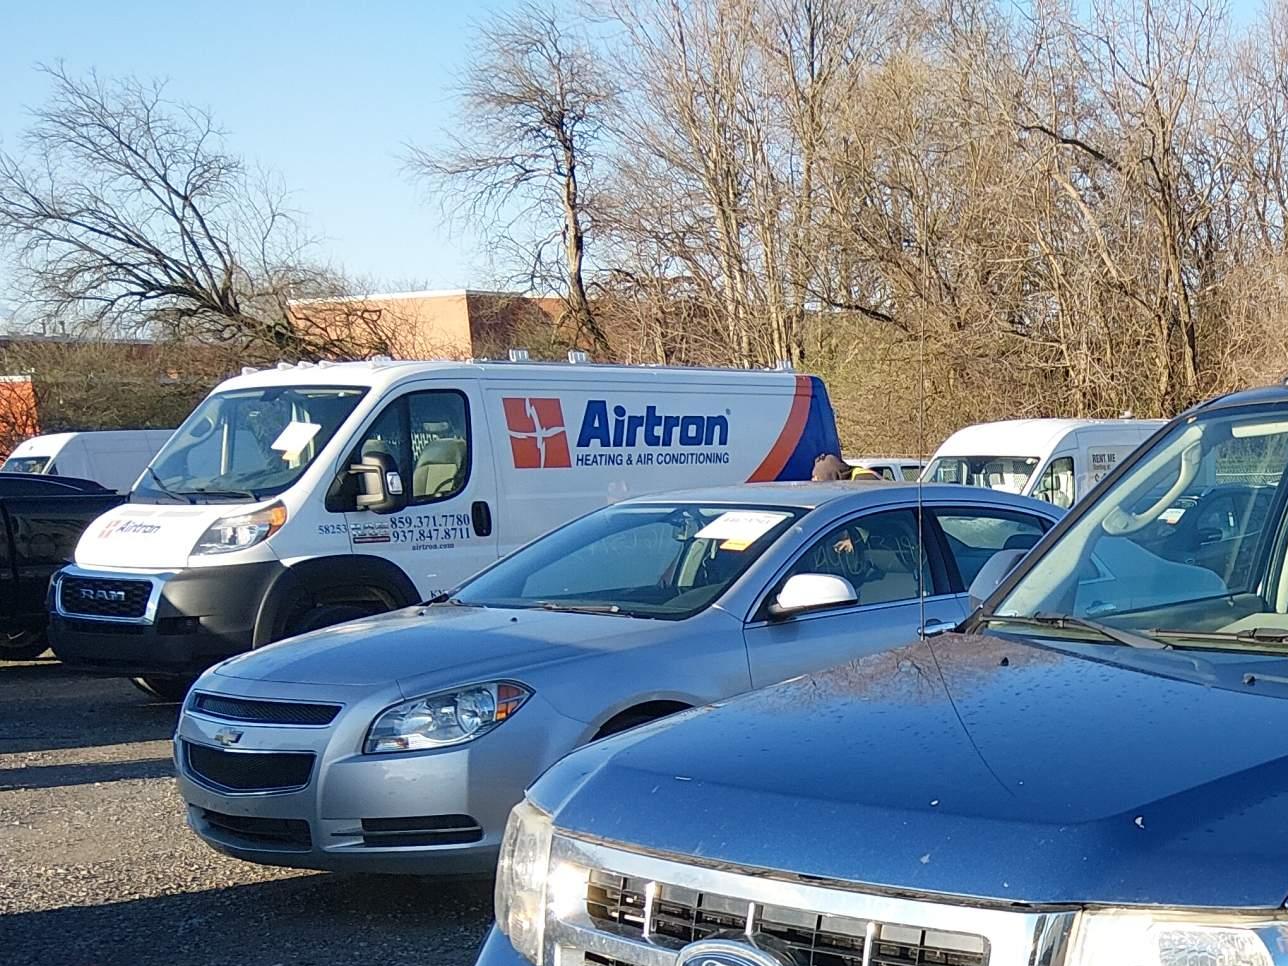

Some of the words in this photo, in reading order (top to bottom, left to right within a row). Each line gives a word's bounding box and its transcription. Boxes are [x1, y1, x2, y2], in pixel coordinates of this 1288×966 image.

[577, 400, 729, 447] Airtron
[576, 453, 623, 466] HEATING
[626, 453, 633, 465] &
[635, 453, 654, 465] AIR
[656, 452, 730, 465] CONDITIONING
[115, 520, 161, 534] Airtron
[390, 514, 470, 530] 859.371.7780
[318, 524, 347, 535] 58253
[392, 528, 470, 543] 937.847.8711
[412, 543, 455, 551] airtron.com
[80, 588, 125, 600] RAM
